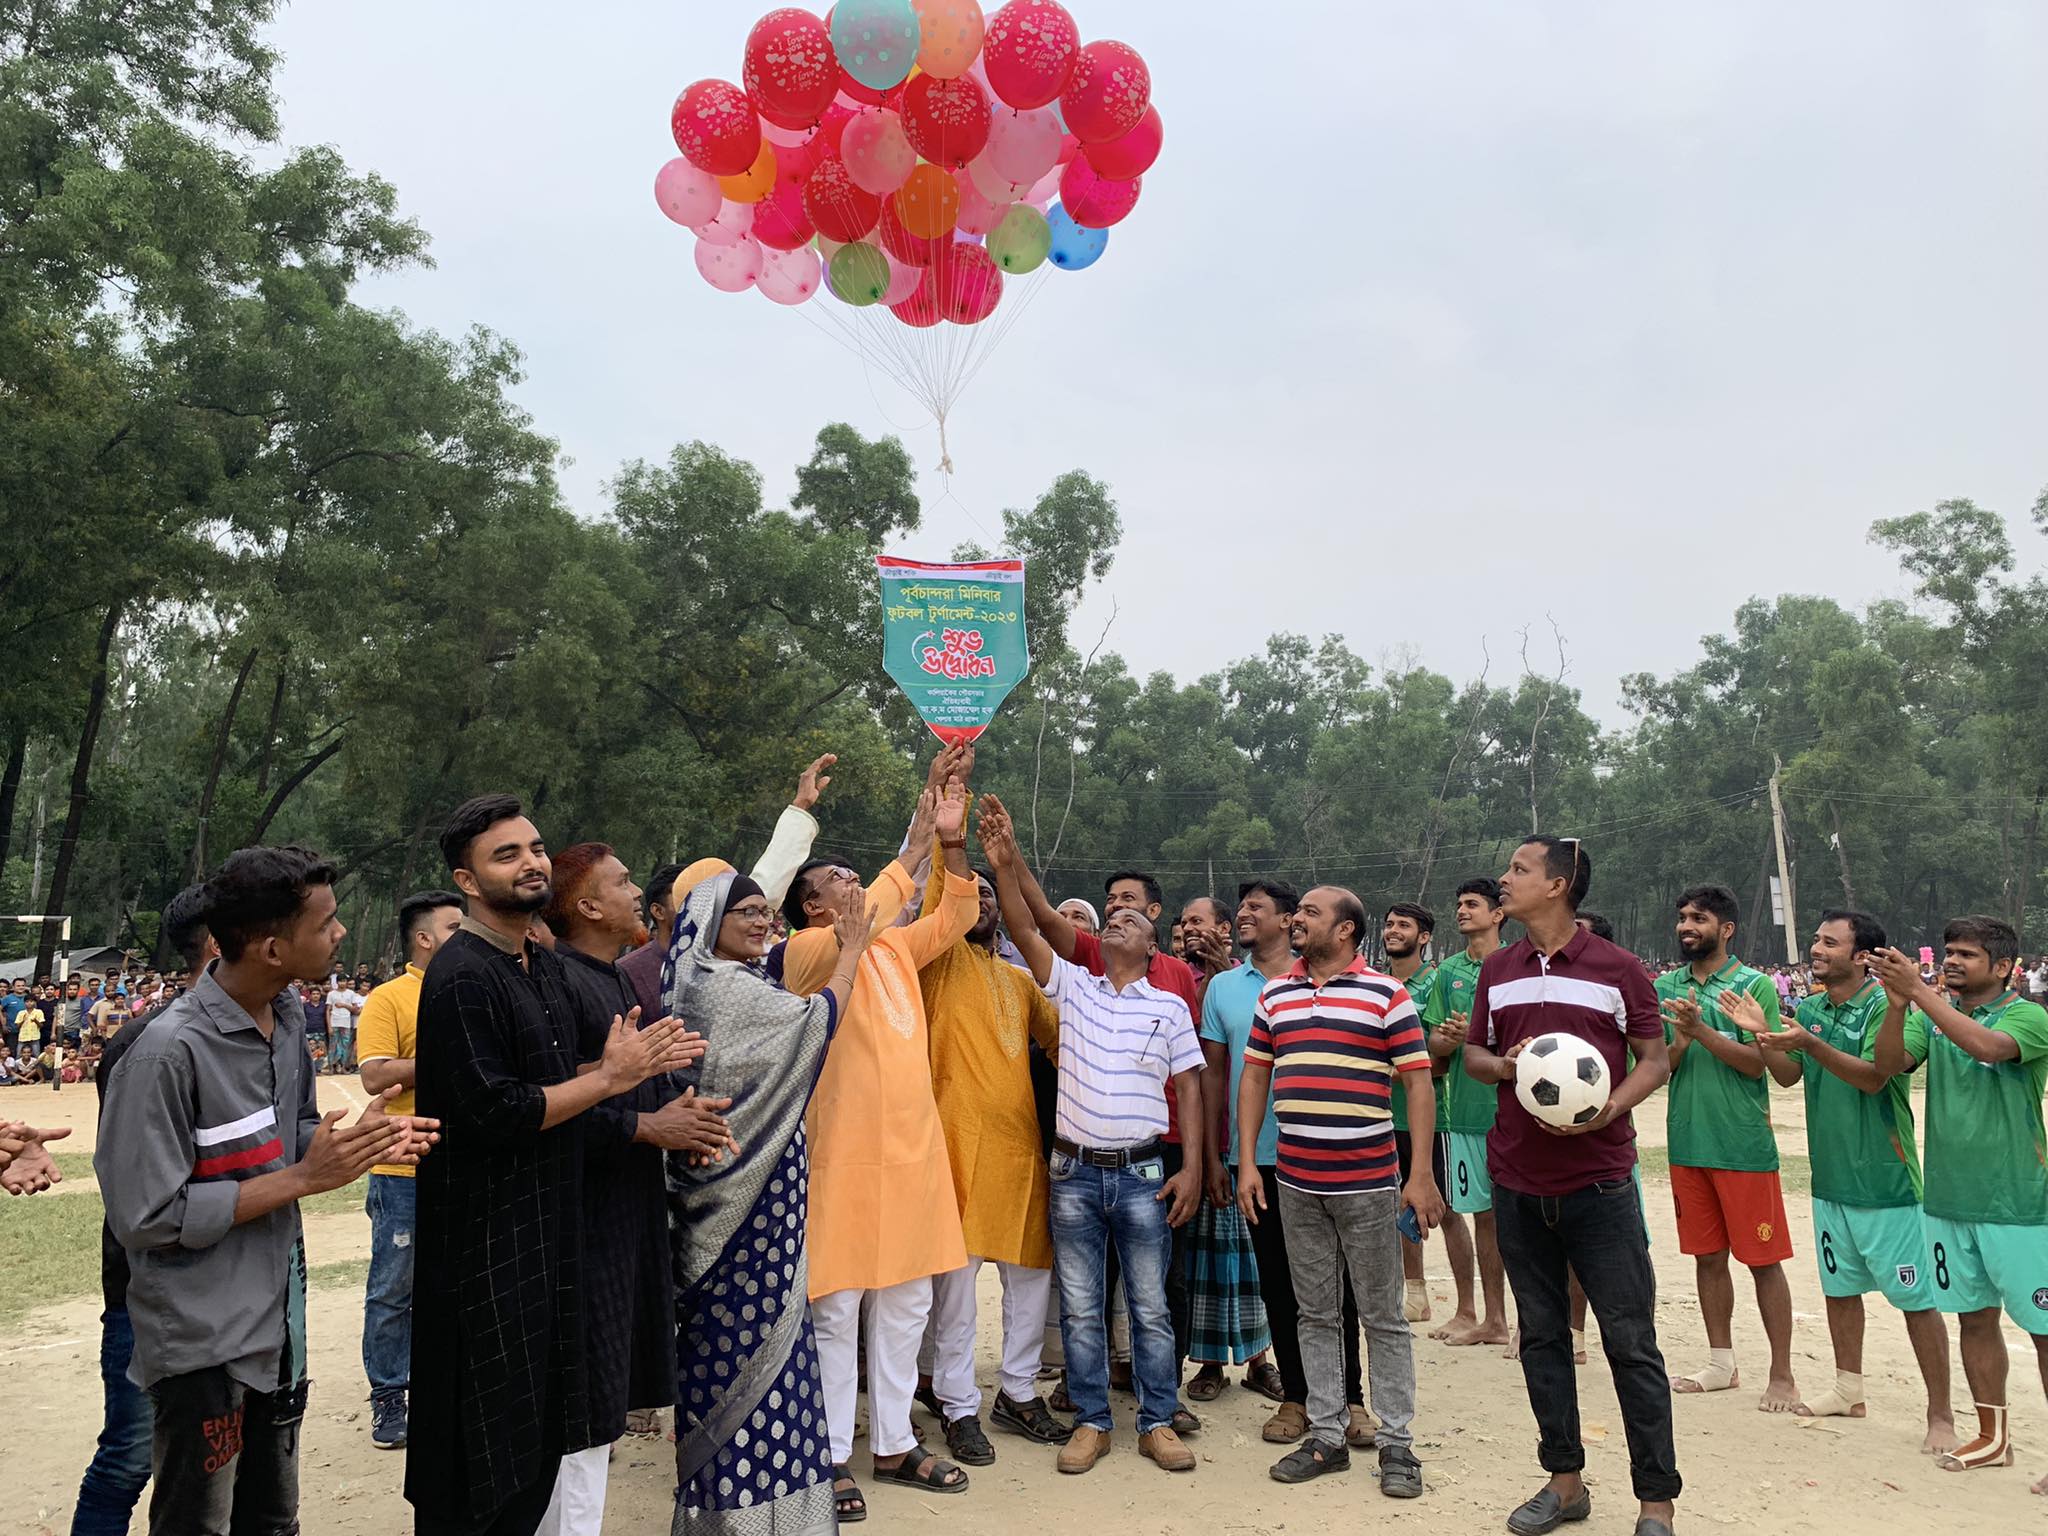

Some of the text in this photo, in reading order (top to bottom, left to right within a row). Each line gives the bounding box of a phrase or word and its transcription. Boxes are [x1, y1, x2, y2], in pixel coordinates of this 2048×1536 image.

[786, 43, 803, 57] you
[787, 35, 806, 47] love
[958, 584, 1002, 602] মিনিবার
[886, 604, 924, 624] ফুটবল
[941, 627, 983, 656] শুভ
[1457, 1159, 1469, 1197] 9
[1821, 1230, 1838, 1275] 6
[1933, 1241, 1950, 1291] 8
